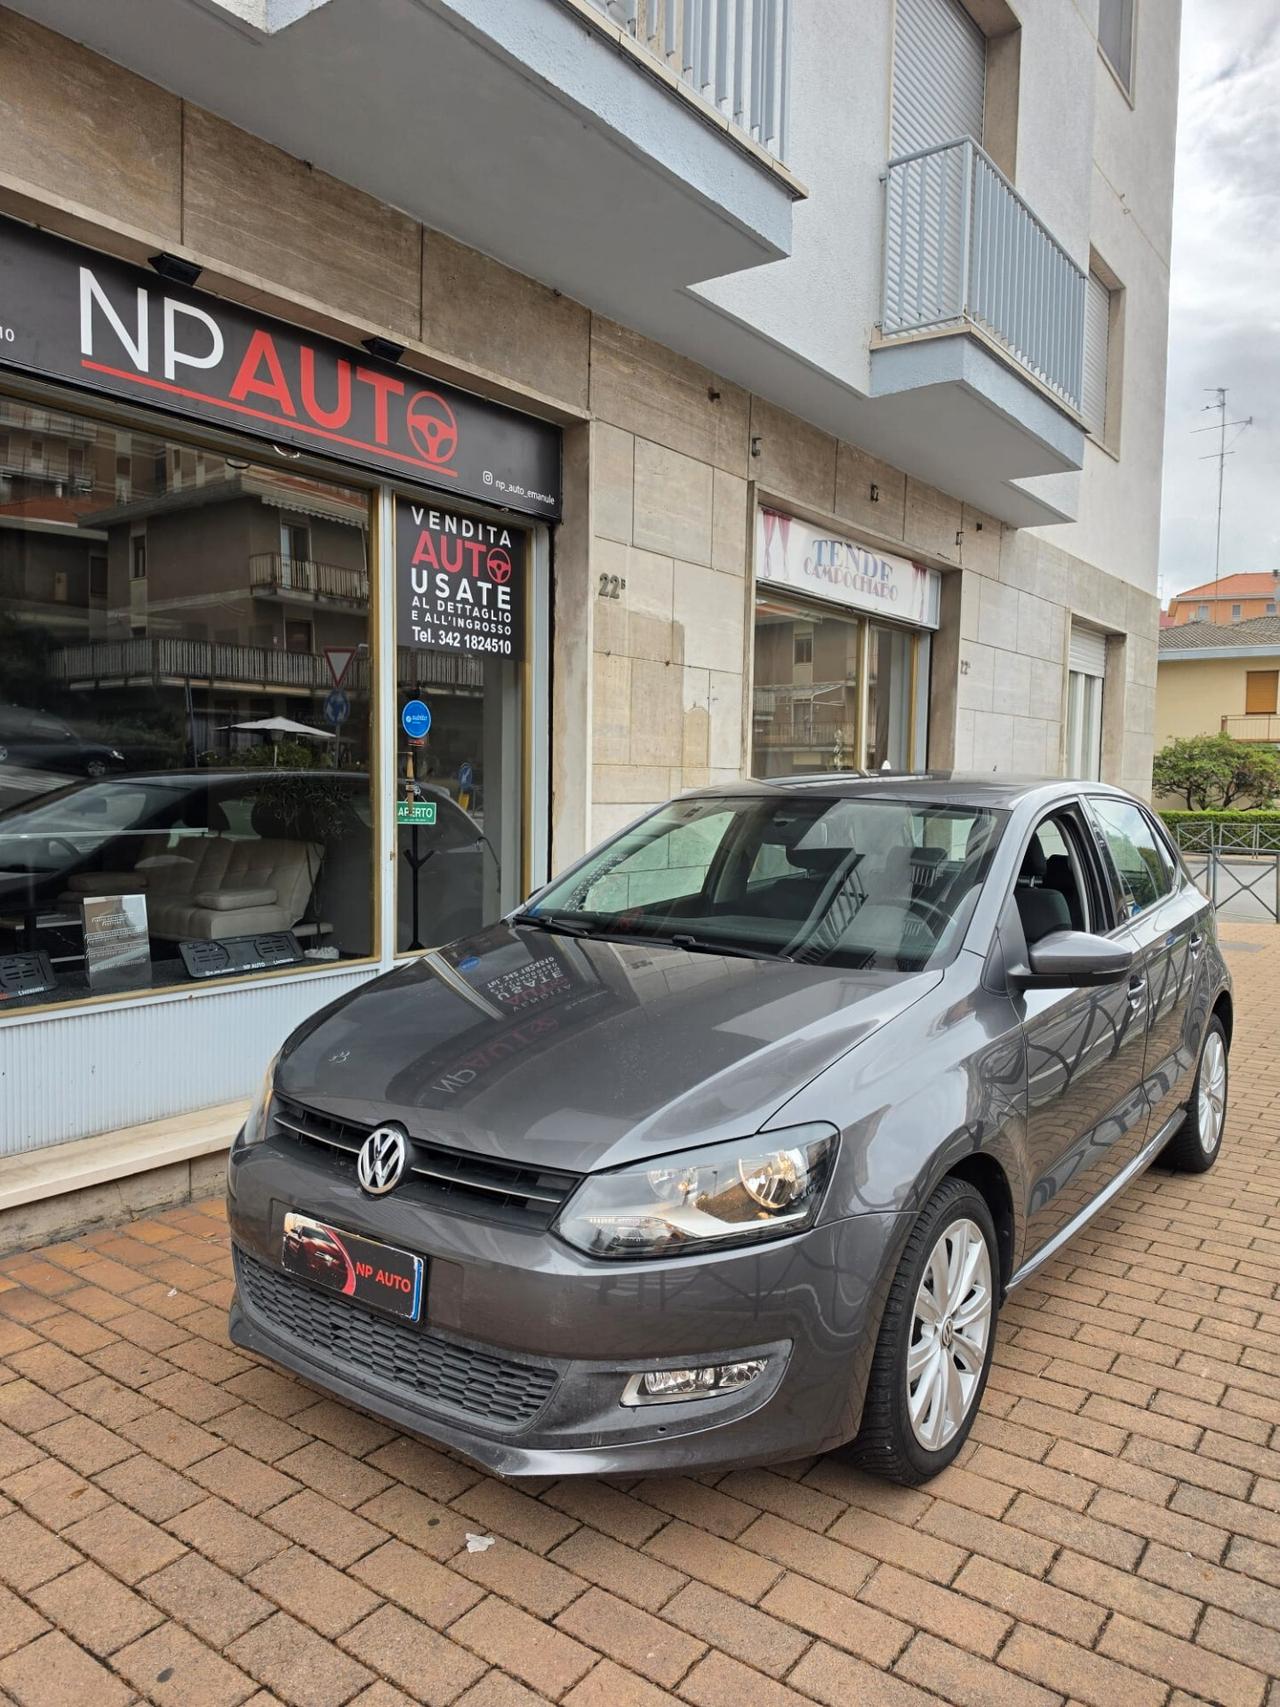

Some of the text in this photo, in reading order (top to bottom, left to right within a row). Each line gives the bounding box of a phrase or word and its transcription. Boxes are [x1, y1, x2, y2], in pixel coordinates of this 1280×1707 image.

[411, 505, 511, 548] VENDITA
[411, 567, 511, 610] USATE
[412, 595, 511, 623] AL DETTAGLIO
[412, 610, 511, 636] E ALL'INGROSSO
[412, 626, 511, 655] Tel. 342 1824510
[355, 1261, 412, 1293] NP AUTO
